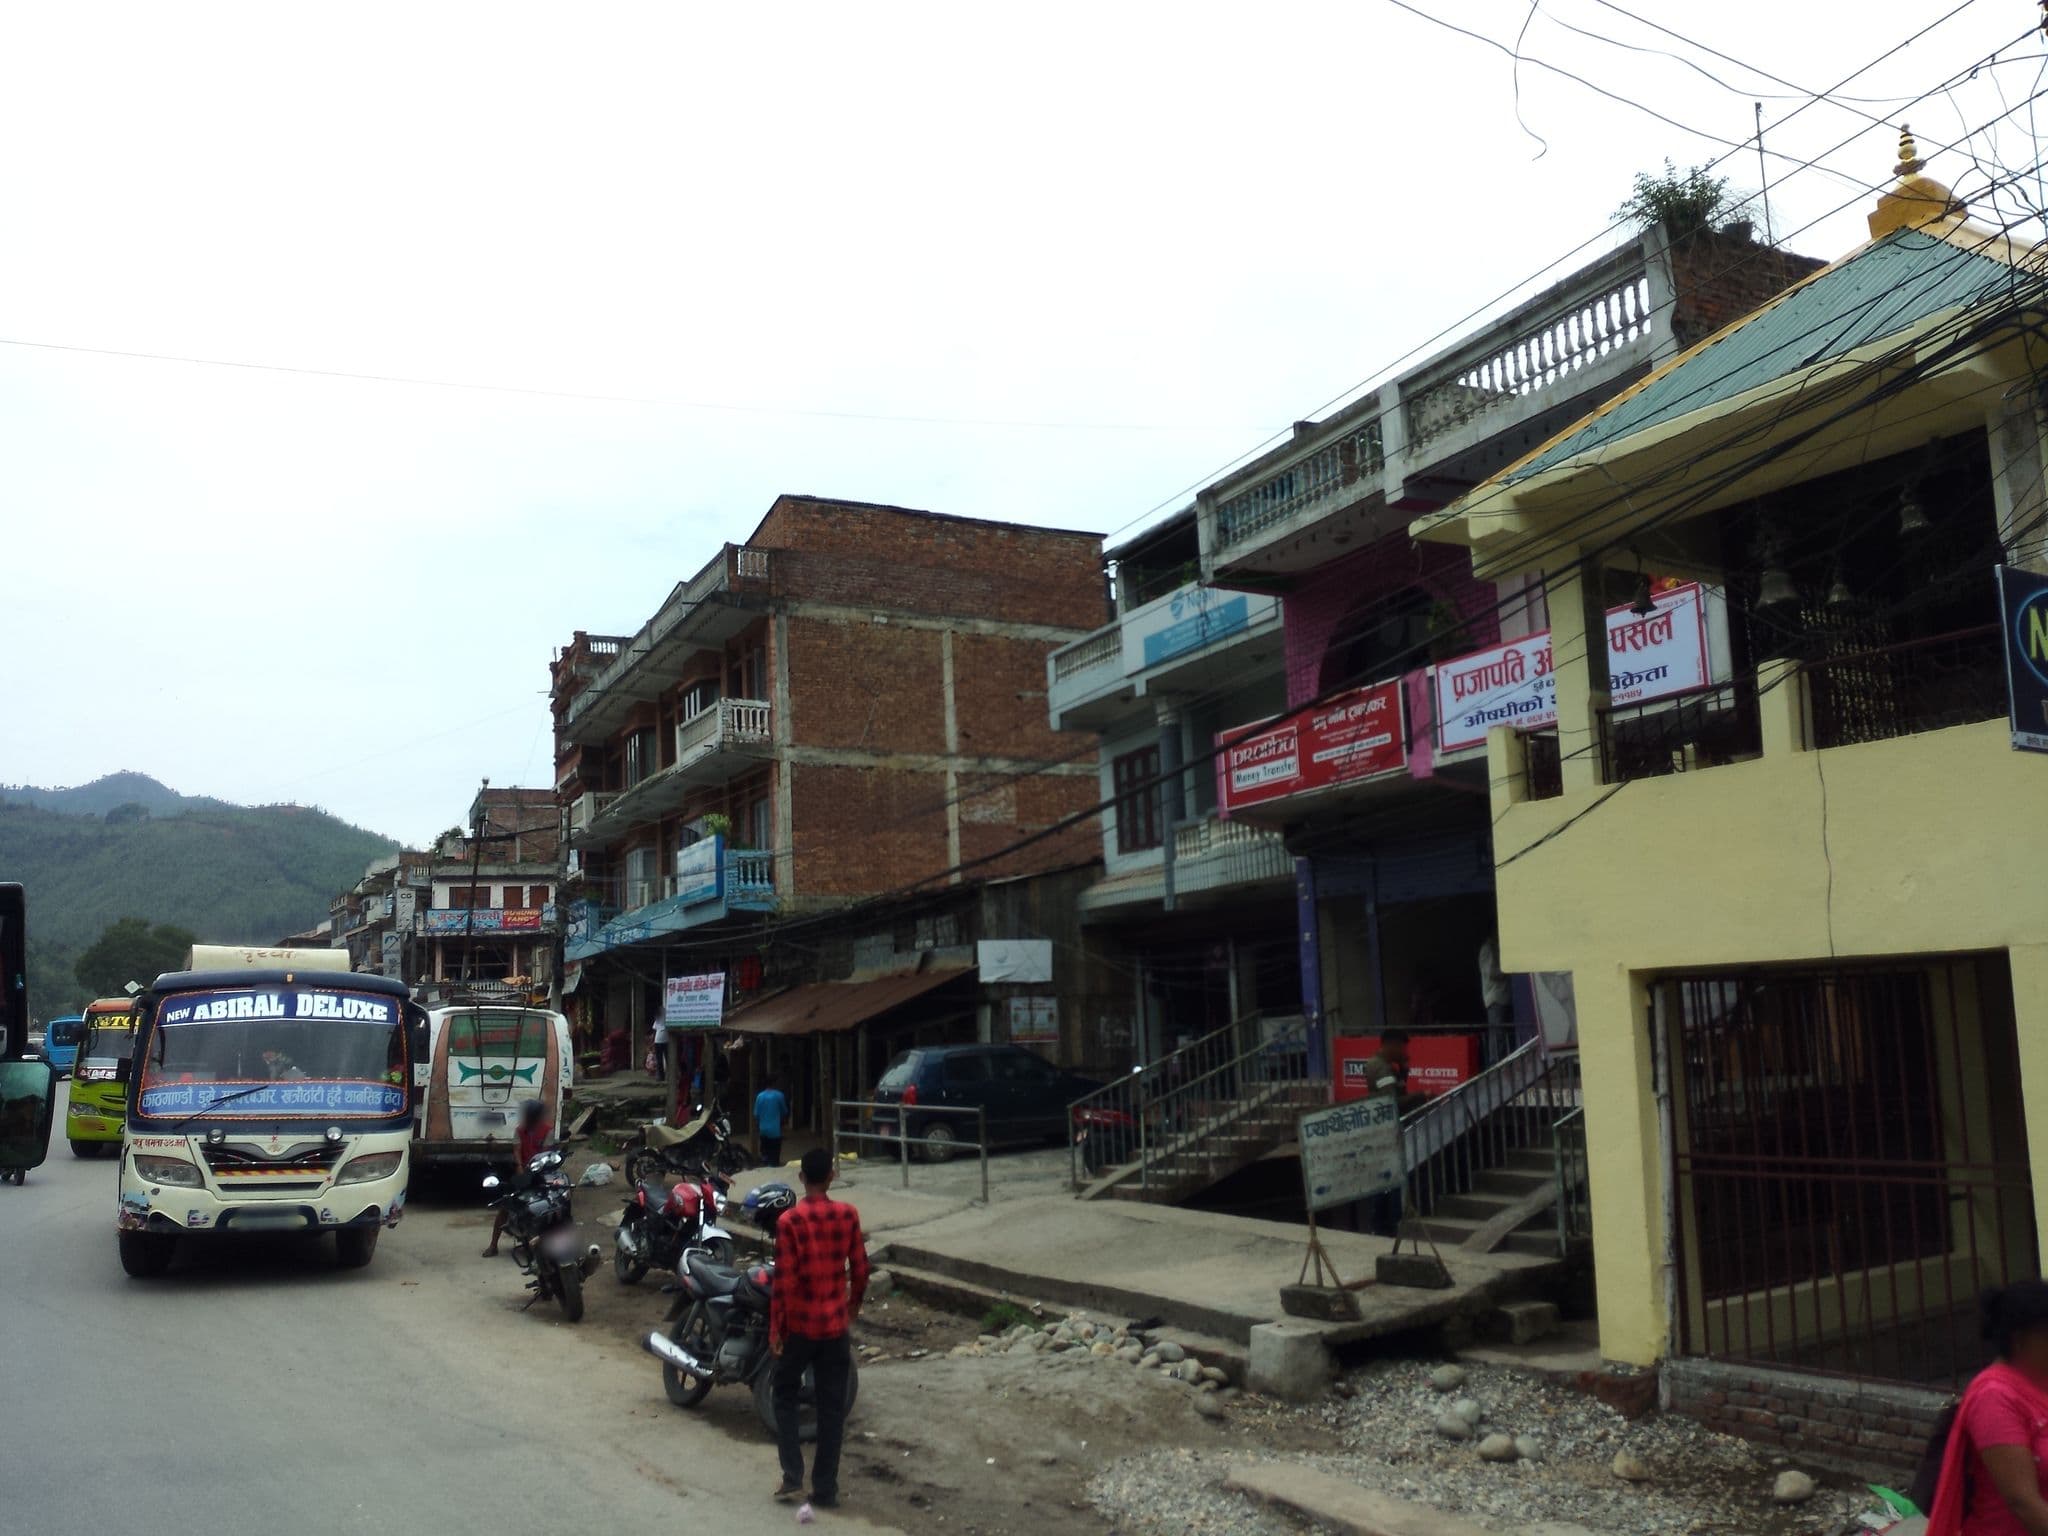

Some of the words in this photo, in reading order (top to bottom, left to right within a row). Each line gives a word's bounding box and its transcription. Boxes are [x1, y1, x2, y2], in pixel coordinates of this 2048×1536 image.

[1609, 610, 1673, 653] पसल
[1452, 649, 1525, 702] प्रजापति
[1236, 768, 1260, 784] Money
[1264, 759, 1296, 777] Transfer
[166, 1007, 191, 1023] NEW
[193, 994, 285, 1021] ABIRAL
[296, 993, 388, 1020] DELUXE
[1425, 1068, 1459, 1078] CENTER
